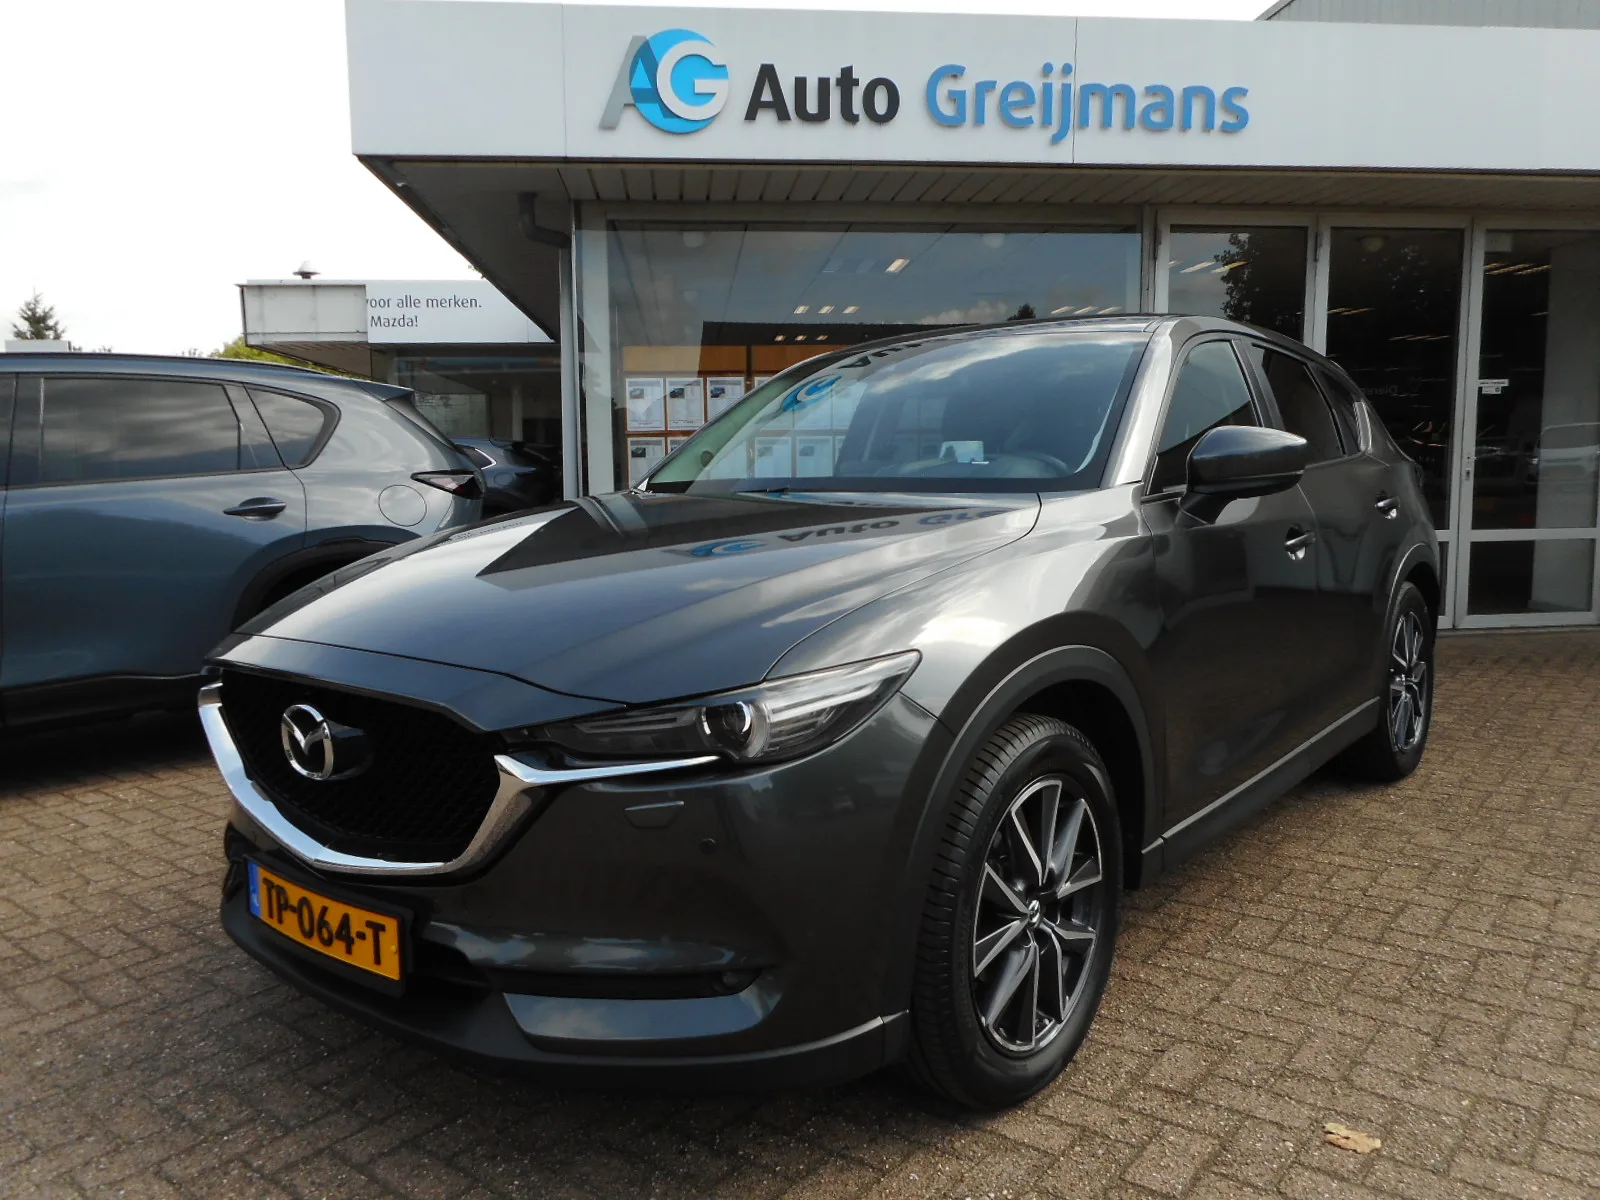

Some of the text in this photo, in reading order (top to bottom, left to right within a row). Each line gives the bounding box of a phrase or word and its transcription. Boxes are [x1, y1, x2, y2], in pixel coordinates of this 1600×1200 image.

[743, 63, 901, 123] Auto
[926, 61, 1249, 144] Greijmans
[366, 294, 482, 309] oor alle merken.
[370, 314, 418, 328] Mazda!
[262, 877, 386, 966] TP-064-T
